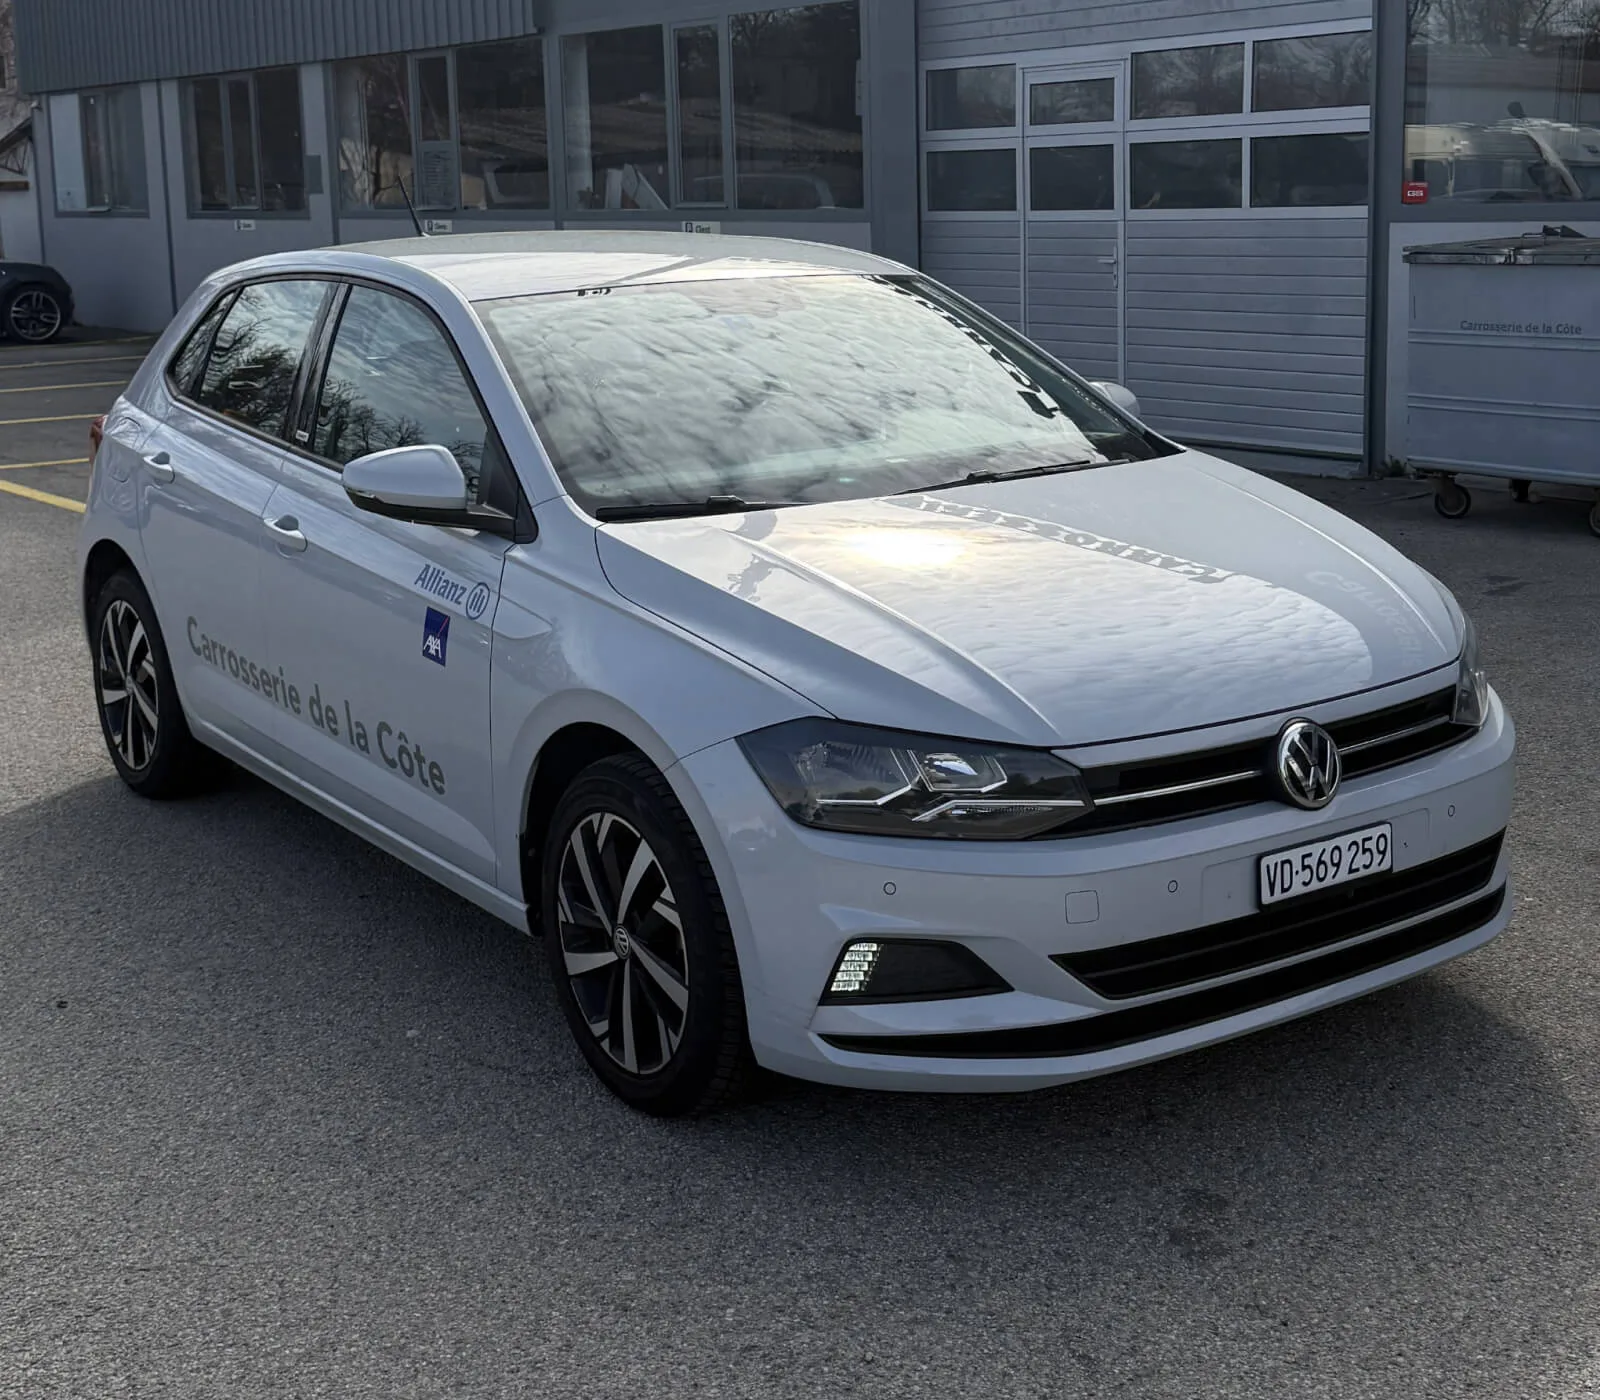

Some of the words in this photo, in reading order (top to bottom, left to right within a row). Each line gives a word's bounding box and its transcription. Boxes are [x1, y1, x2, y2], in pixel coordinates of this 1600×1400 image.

[1460, 320, 1522, 333] Carrosserie
[1525, 322, 1539, 333] de
[1542, 323, 1553, 334] la
[1556, 323, 1582, 335] Côte
[414, 563, 468, 606] Allianz
[423, 634, 442, 660] AXA
[187, 615, 302, 715] Carrosserie
[308, 683, 340, 737] de
[344, 699, 371, 755] la
[376, 720, 447, 796] Côte
